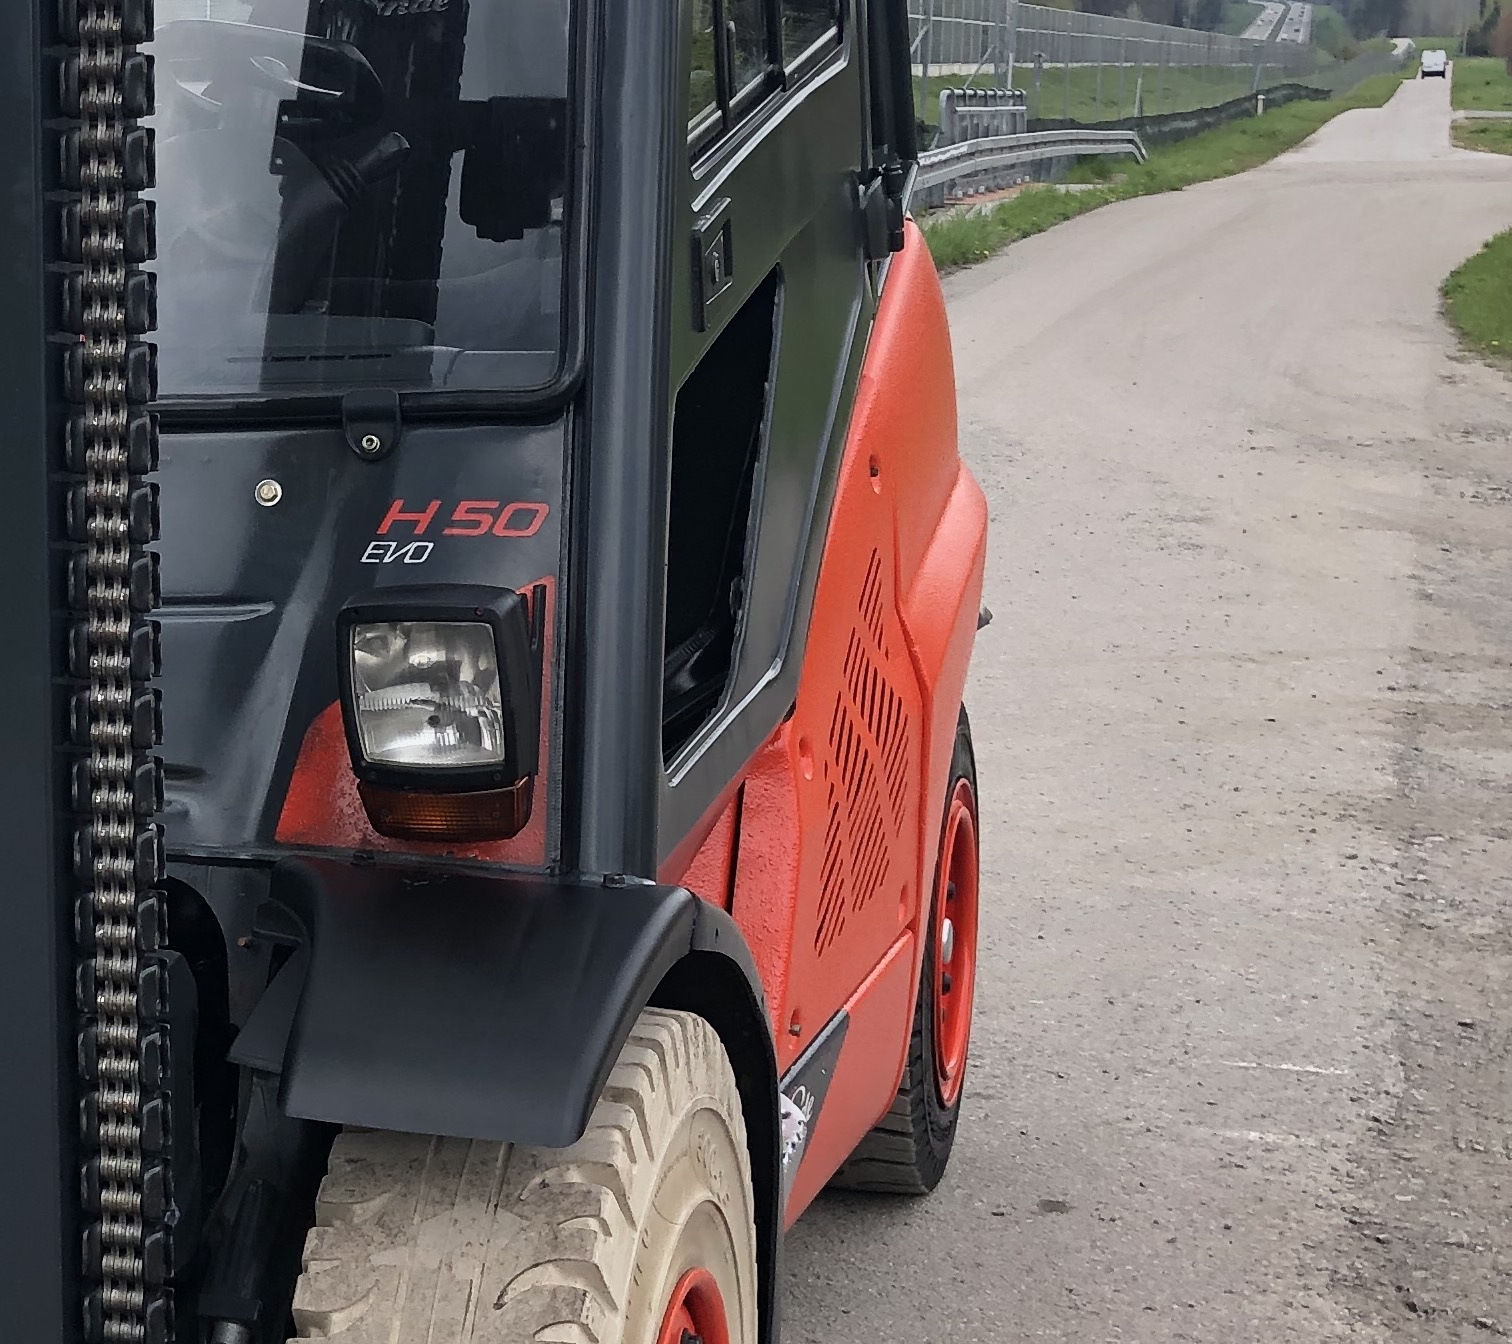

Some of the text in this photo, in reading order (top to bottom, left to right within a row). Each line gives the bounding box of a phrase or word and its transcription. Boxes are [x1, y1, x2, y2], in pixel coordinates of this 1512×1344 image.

[376, 499, 550, 537] H 50
[359, 541, 434, 564] EVO
